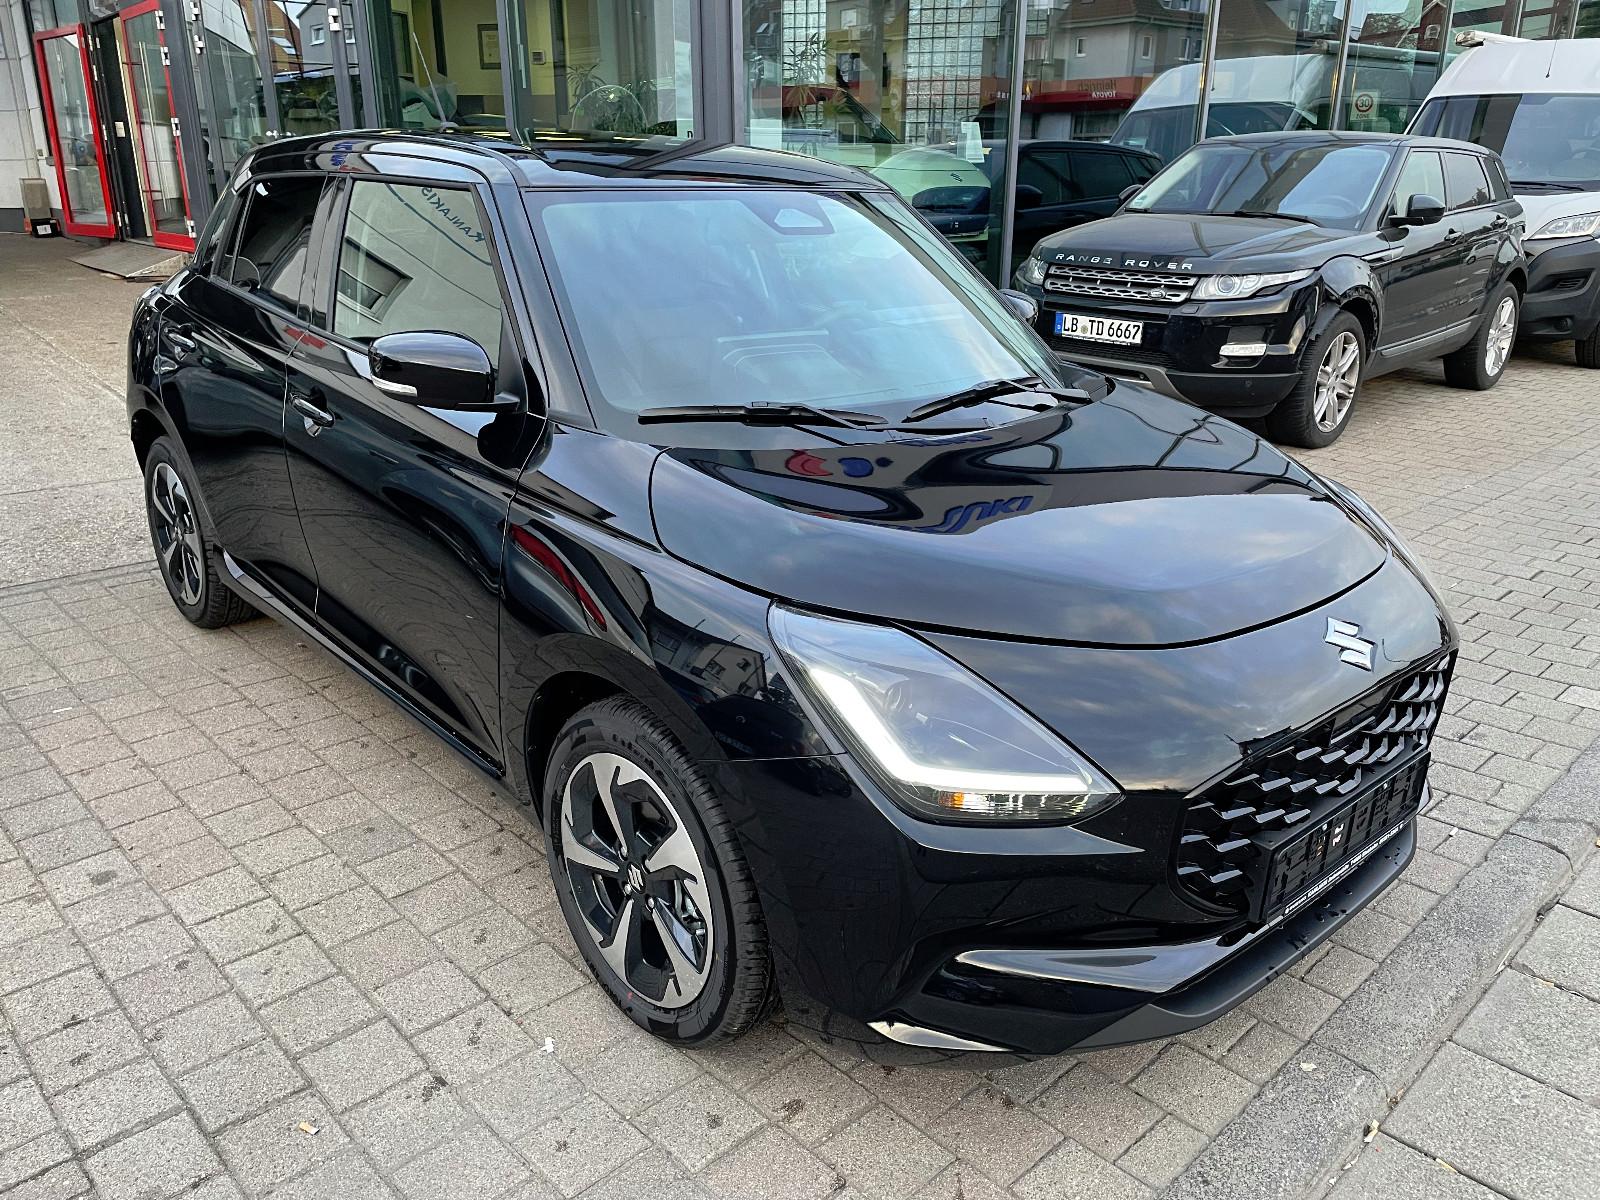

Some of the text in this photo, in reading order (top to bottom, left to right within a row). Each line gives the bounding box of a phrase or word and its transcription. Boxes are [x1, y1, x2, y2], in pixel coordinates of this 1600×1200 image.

[1055, 253, 1193, 270] RANGE ROVER
[1063, 316, 1079, 333] LB
[1088, 319, 1105, 336] TD
[1107, 321, 1141, 340] 6667
